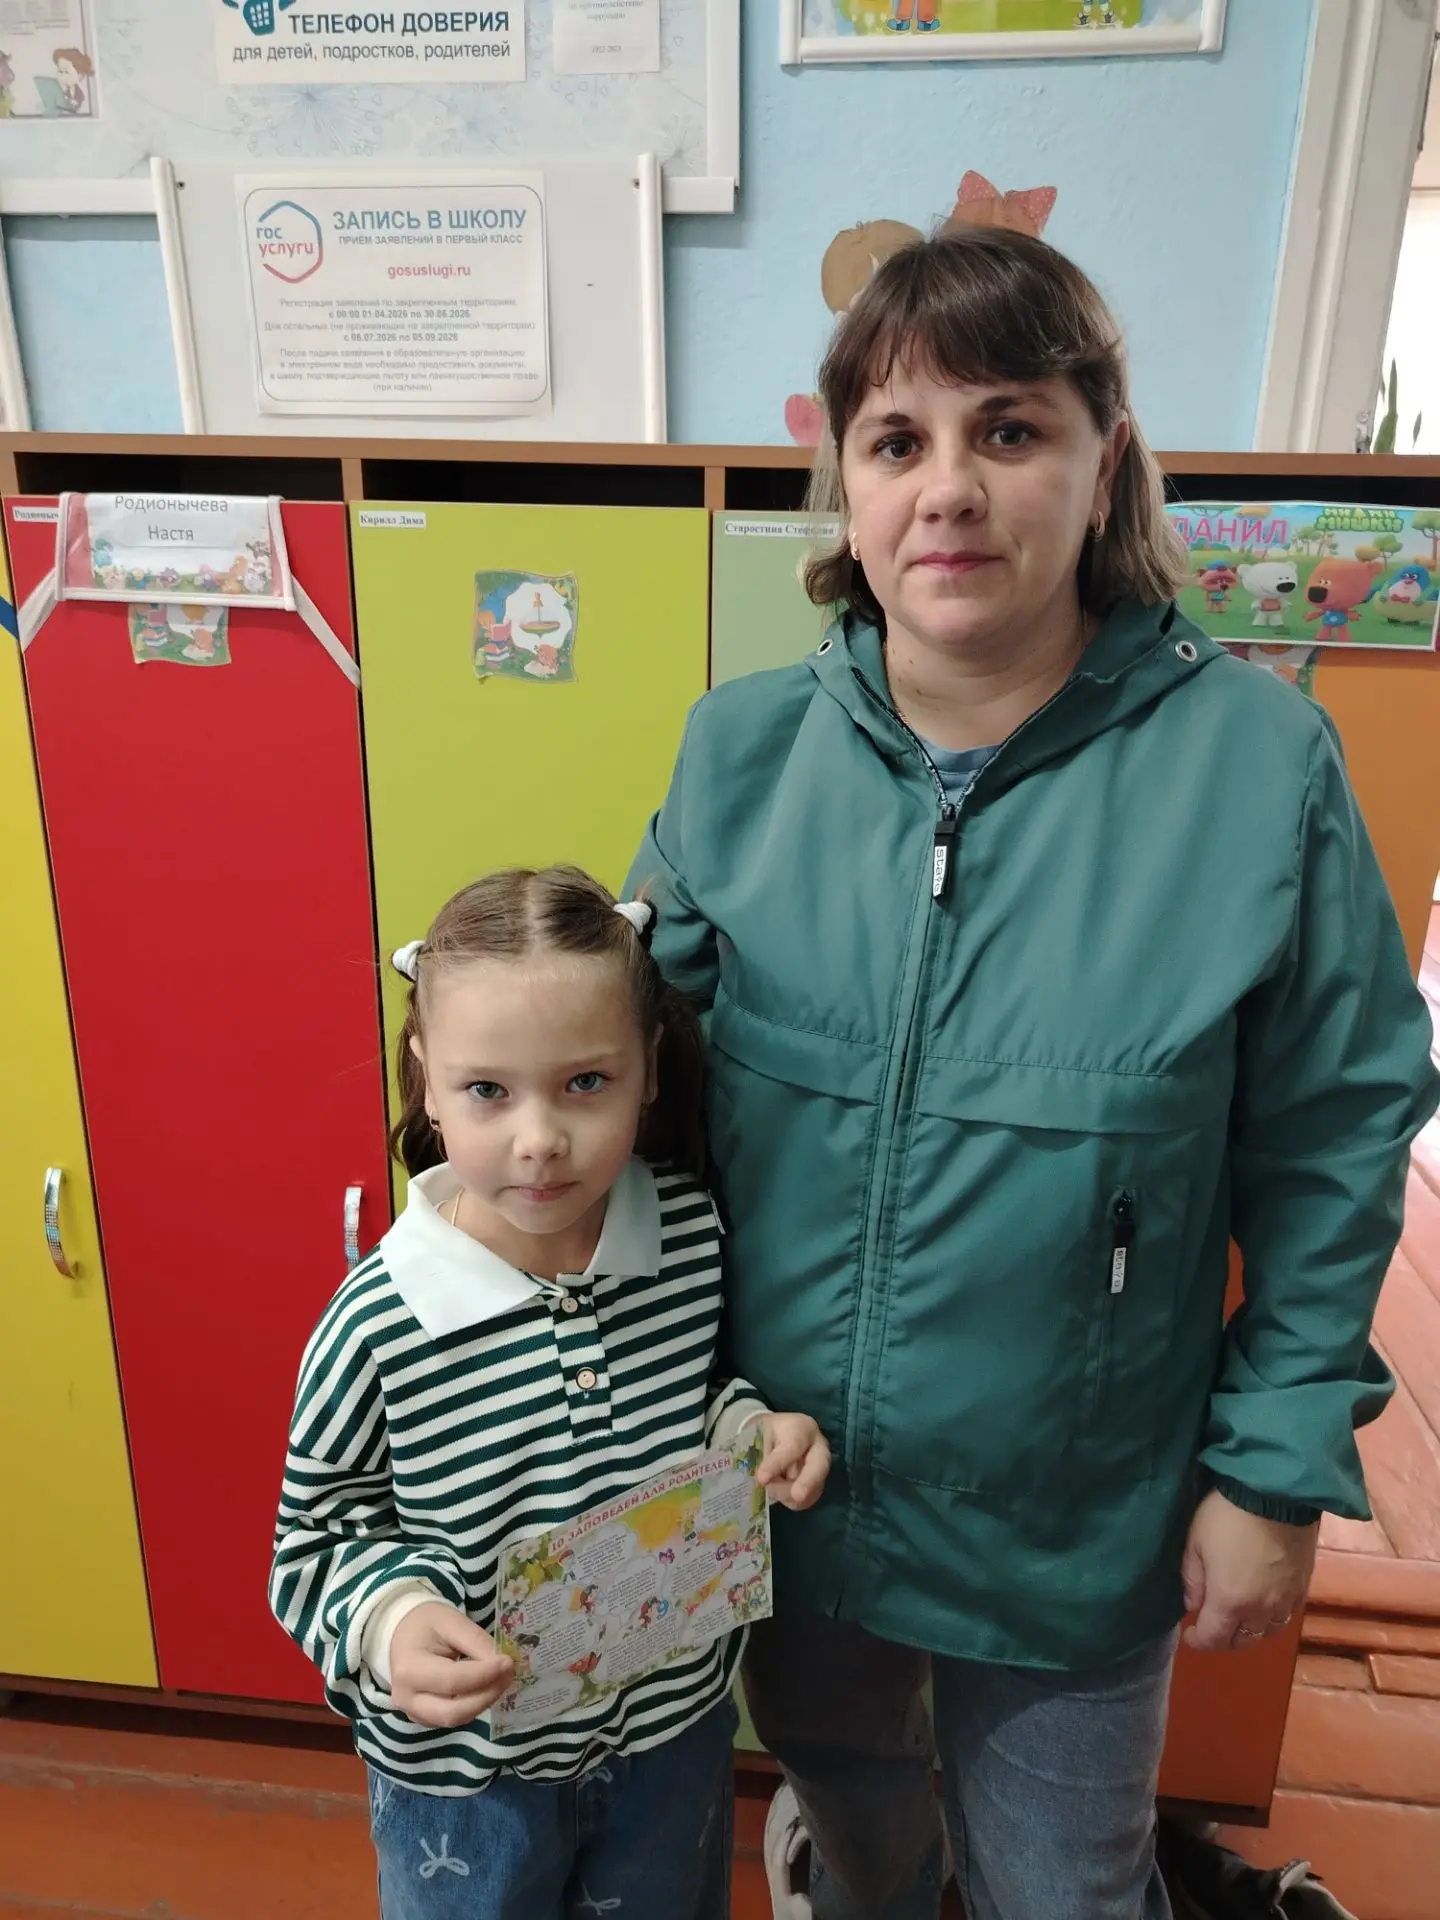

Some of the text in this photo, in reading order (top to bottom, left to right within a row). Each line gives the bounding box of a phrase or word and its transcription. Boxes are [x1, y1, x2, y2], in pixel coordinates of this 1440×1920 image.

[289, 11, 509, 36] ТЕЛЕФОН ДОВЕРИЯ
[233, 42, 511, 61] для детей, подростков, родителей
[333, 209, 527, 231] ЗАПИСЬ В ШКОЛУ
[256, 227, 283, 240] гос
[375, 233, 433, 245] ЗАЯВЛЕНИЙ
[437, 235, 443, 244] В
[446, 232, 487, 244] ПЕРВЫЙ
[490, 234, 523, 244] КЛАСС
[258, 244, 314, 258] услуги
[388, 264, 471, 280] gosuslugi.ru
[411, 311, 422, 319] по
[115, 495, 228, 514] Родионычева
[148, 525, 194, 541] Настя
[725, 522, 782, 534] Старостина
[1174, 517, 1287, 544] ДАНИЛ
[642, 1483, 666, 1502] ДЛЯ
